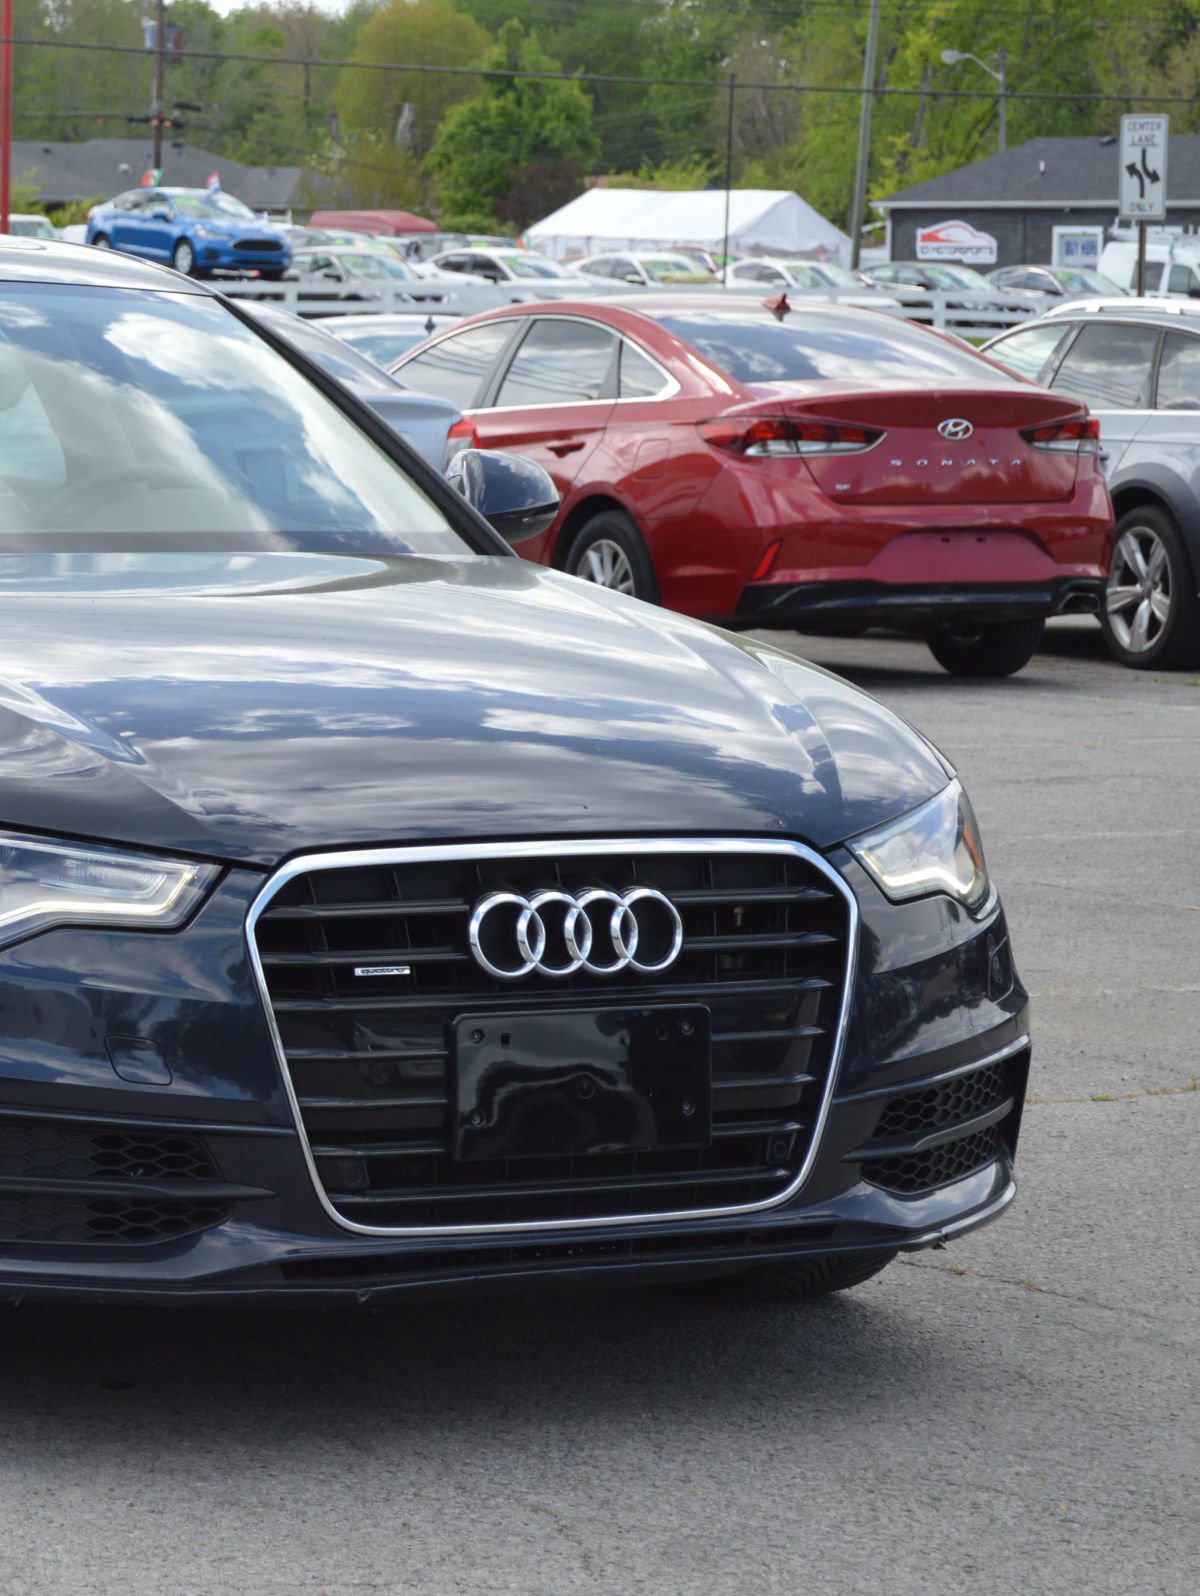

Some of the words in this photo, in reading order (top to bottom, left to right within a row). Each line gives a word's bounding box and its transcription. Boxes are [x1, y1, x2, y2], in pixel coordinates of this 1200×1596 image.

[1127, 121, 1161, 131] CENTER
[1131, 134, 1156, 144] LANE
[1129, 202, 1154, 213] ONLY
[890, 458, 1021, 466] SONATA
